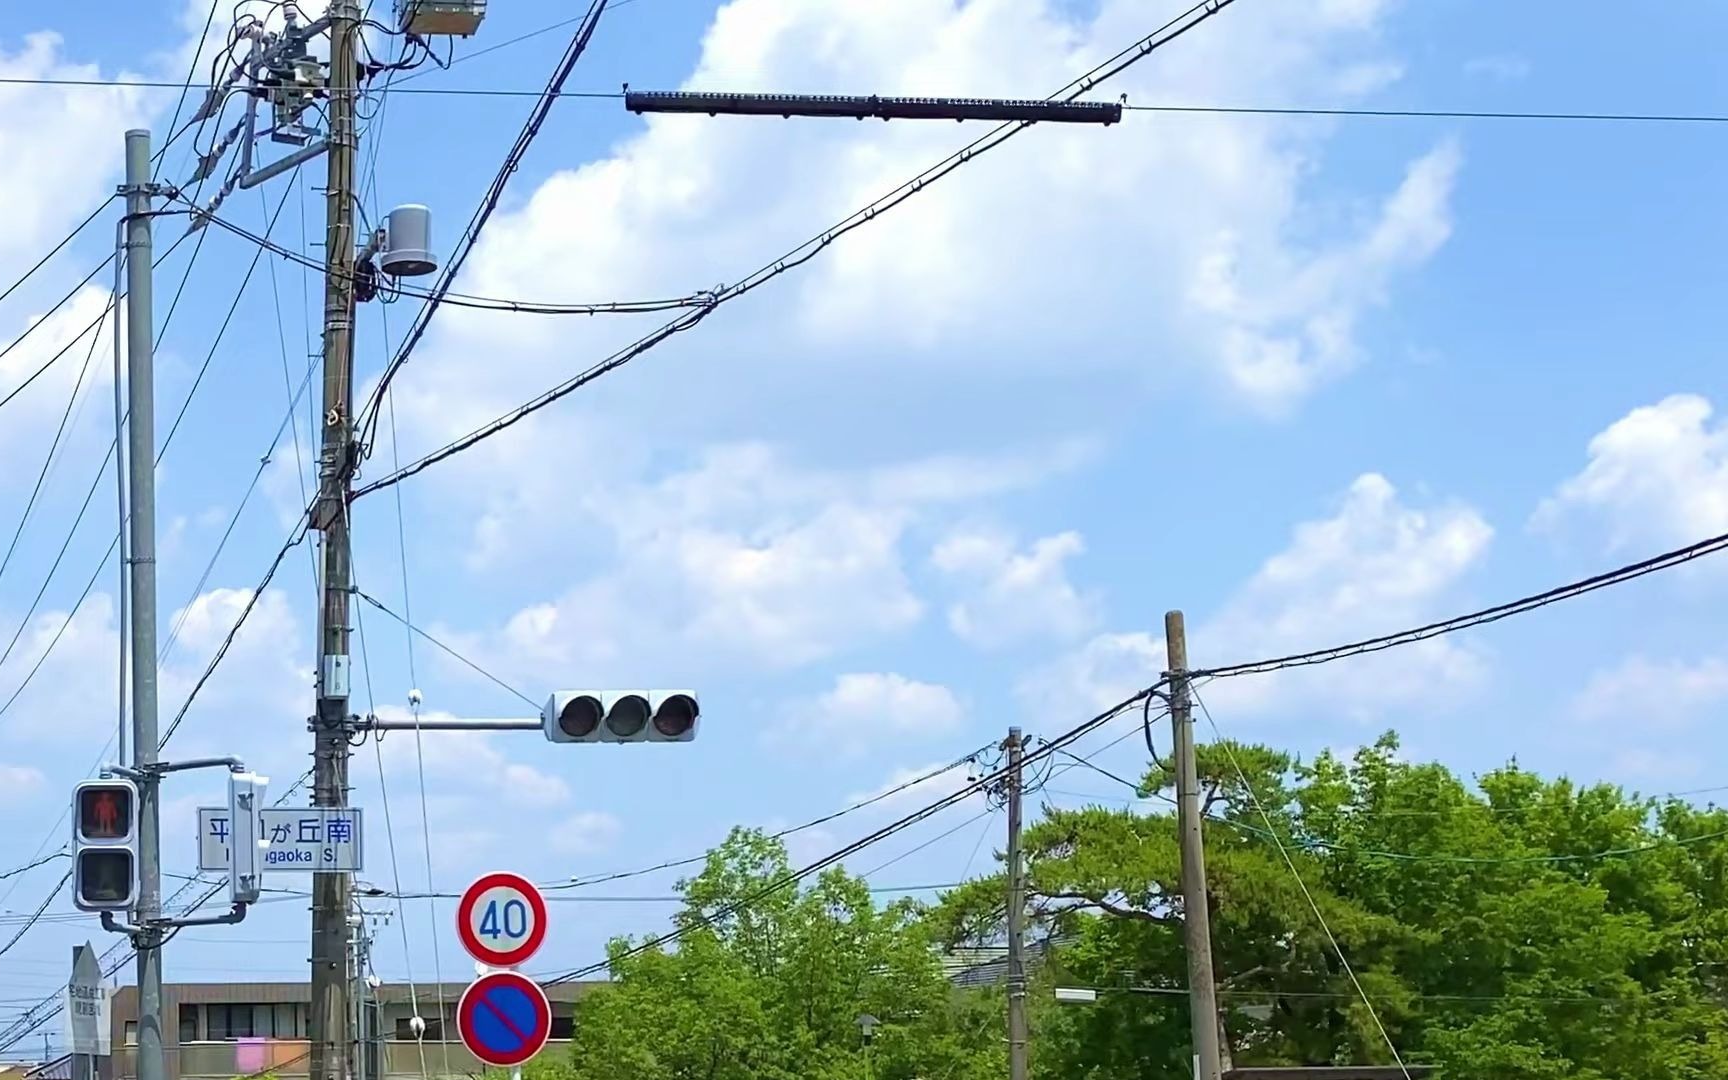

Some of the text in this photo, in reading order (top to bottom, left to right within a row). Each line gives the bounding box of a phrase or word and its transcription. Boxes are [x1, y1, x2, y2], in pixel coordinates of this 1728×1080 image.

[209, 817, 352, 844] 平が丘南
[479, 899, 527, 940] 40
